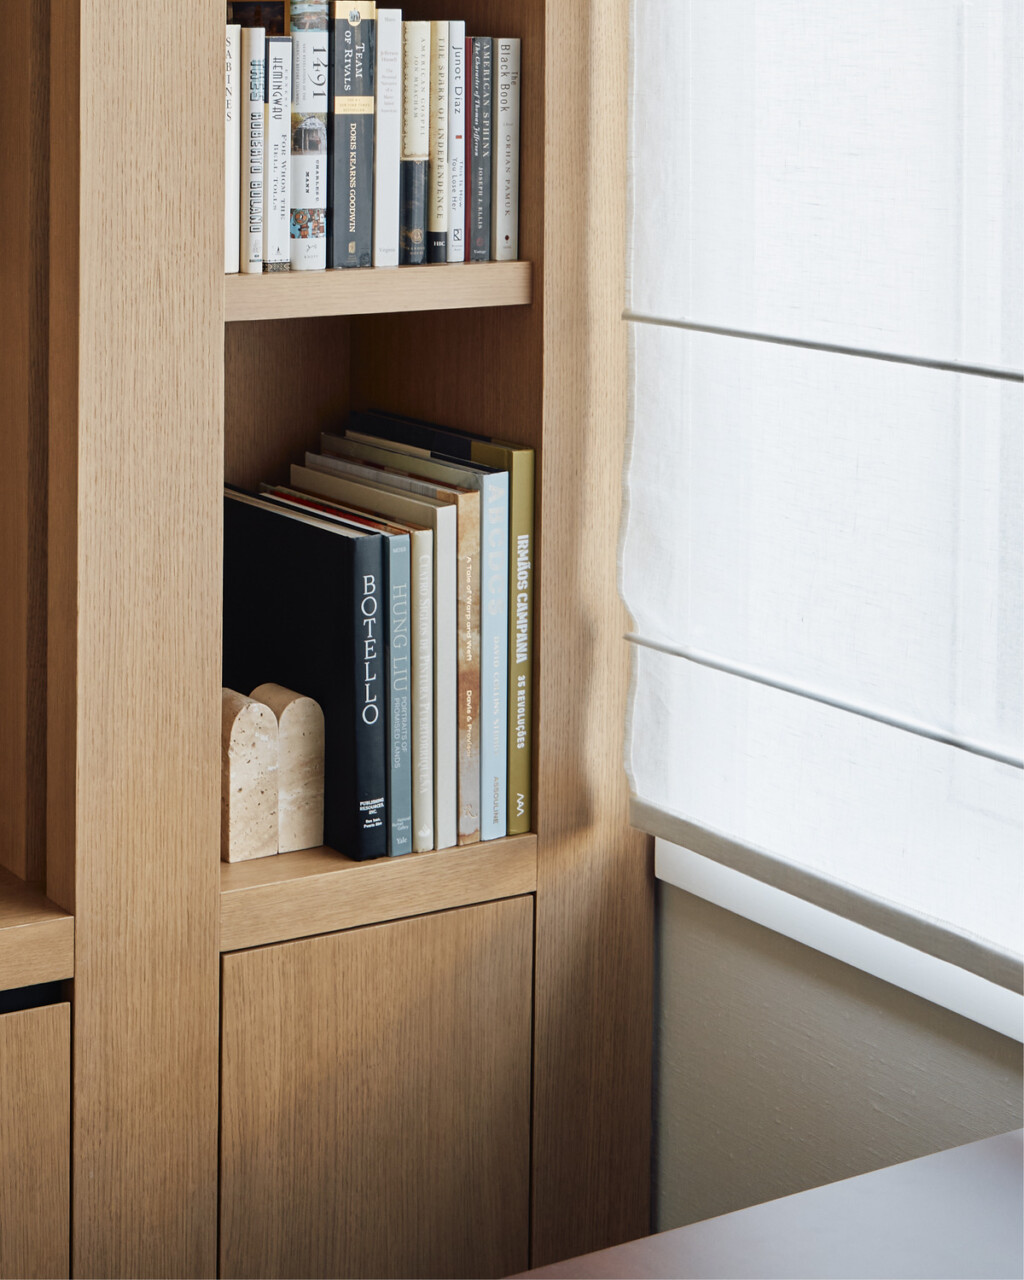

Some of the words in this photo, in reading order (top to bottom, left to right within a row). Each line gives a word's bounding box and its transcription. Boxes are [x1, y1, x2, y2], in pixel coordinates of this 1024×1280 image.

[344, 30, 352, 45] OF
[307, 45, 329, 99] 1491
[344, 49, 354, 92] RIVALS
[355, 42, 366, 78] TEAM
[452, 44, 463, 80] Junot
[482, 42, 490, 106] AMERICAN
[500, 44, 510, 77] Black
[272, 56, 283, 120] HEMINGWAY
[473, 90, 480, 98] of
[510, 71, 518, 86] The
[437, 108, 445, 120] OF
[500, 84, 510, 112] Book
[250, 112, 263, 174] ROBERTO
[349, 122, 357, 150] DORIS
[482, 112, 490, 158] SPHINX
[349, 151, 357, 188] KEARNS
[436, 128, 444, 219] INDEPENDENCE
[348, 189, 356, 233] GOODWIN
[517, 534, 532, 591] IRMÃOS
[466, 584, 472, 594] of
[392, 583, 408, 648] HUNG
[516, 592, 528, 664] CAMPANA
[360, 574, 379, 725] BOTELLO
[393, 656, 408, 692] LIU
[517, 674, 526, 688] 35
[466, 715, 472, 723] &
[515, 690, 526, 749] REVOLUÇÕES
[401, 741, 408, 752] OF
[396, 836, 408, 844] Yale
